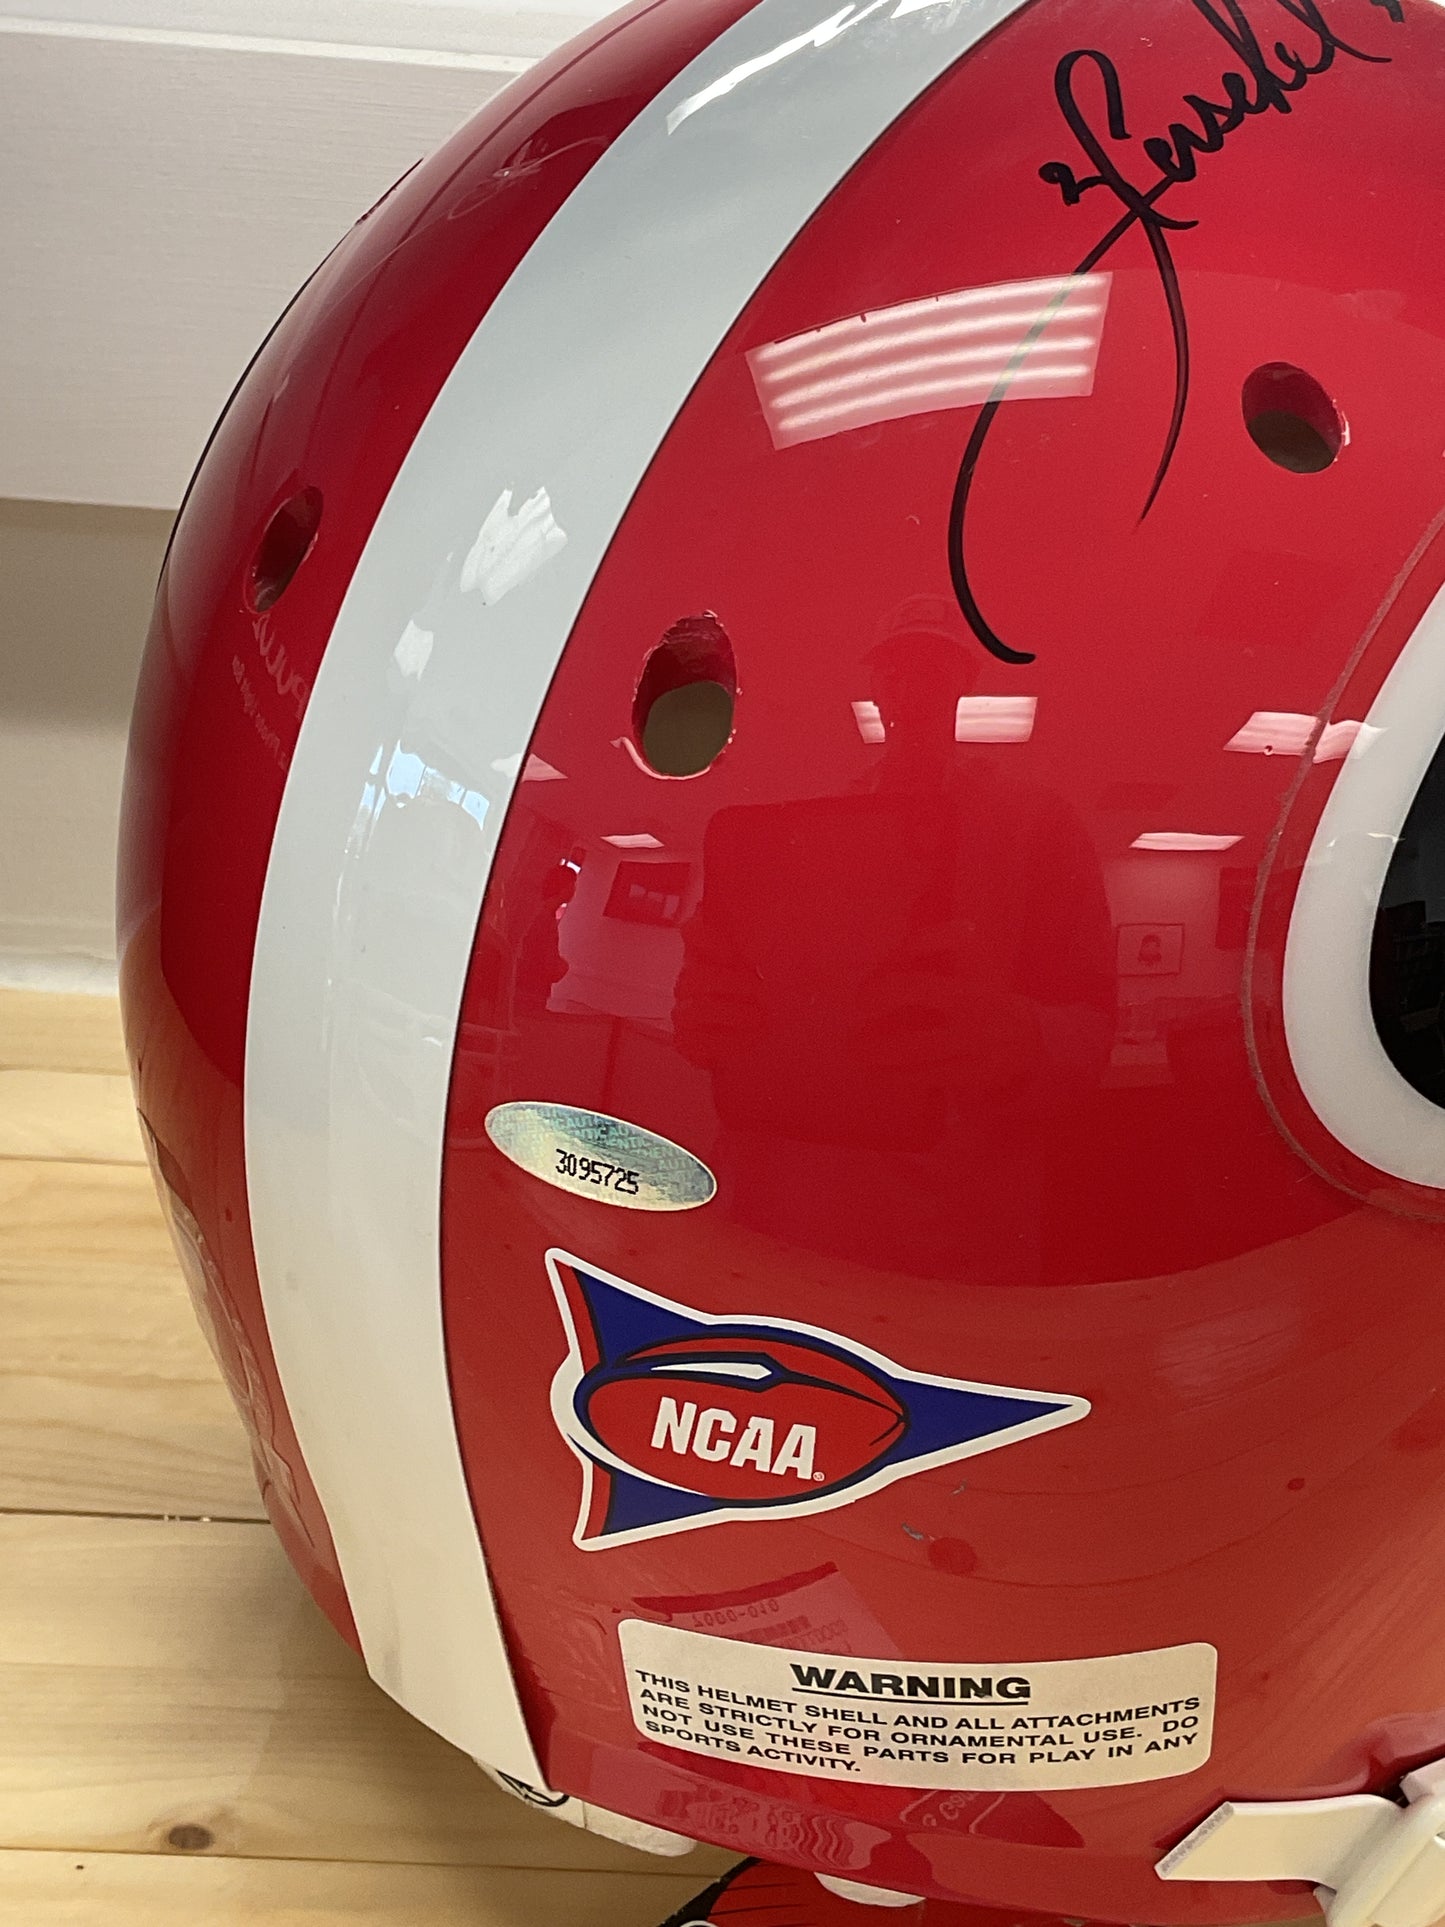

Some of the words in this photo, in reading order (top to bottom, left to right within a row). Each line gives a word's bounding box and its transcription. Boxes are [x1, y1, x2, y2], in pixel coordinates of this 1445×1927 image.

[555, 1148, 640, 1195] 3095725
[635, 1669, 690, 1693] THIS
[697, 1684, 798, 1714] HELMET
[805, 1704, 888, 1726] SHELL
[893, 1714, 948, 1729] AND
[954, 1717, 1005, 1730] ALL
[1011, 1697, 1200, 1729] ATTACHMENTS
[789, 1663, 1031, 1699] WARNING
[640, 1688, 691, 1710] ARE
[698, 1702, 818, 1734] STRICTLY
[827, 1724, 880, 1741] FOR
[890, 1732, 1074, 1748] ORNAMENTAL
[1083, 1726, 1143, 1744] USE.
[1162, 1715, 1199, 1733] DO
[642, 1703, 693, 1726] NOT
[703, 1719, 756, 1740] USE
[765, 1731, 851, 1755] THESE
[863, 1745, 949, 1763] PARTS
[961, 1752, 1016, 1764] FOR
[1029, 1748, 1096, 1764] PLAY
[1107, 1744, 1133, 1758] IN
[1144, 1732, 1199, 1754] ANY
[645, 1720, 741, 1752] SPORTS
[747, 1745, 861, 1772] ACTIVITY.
